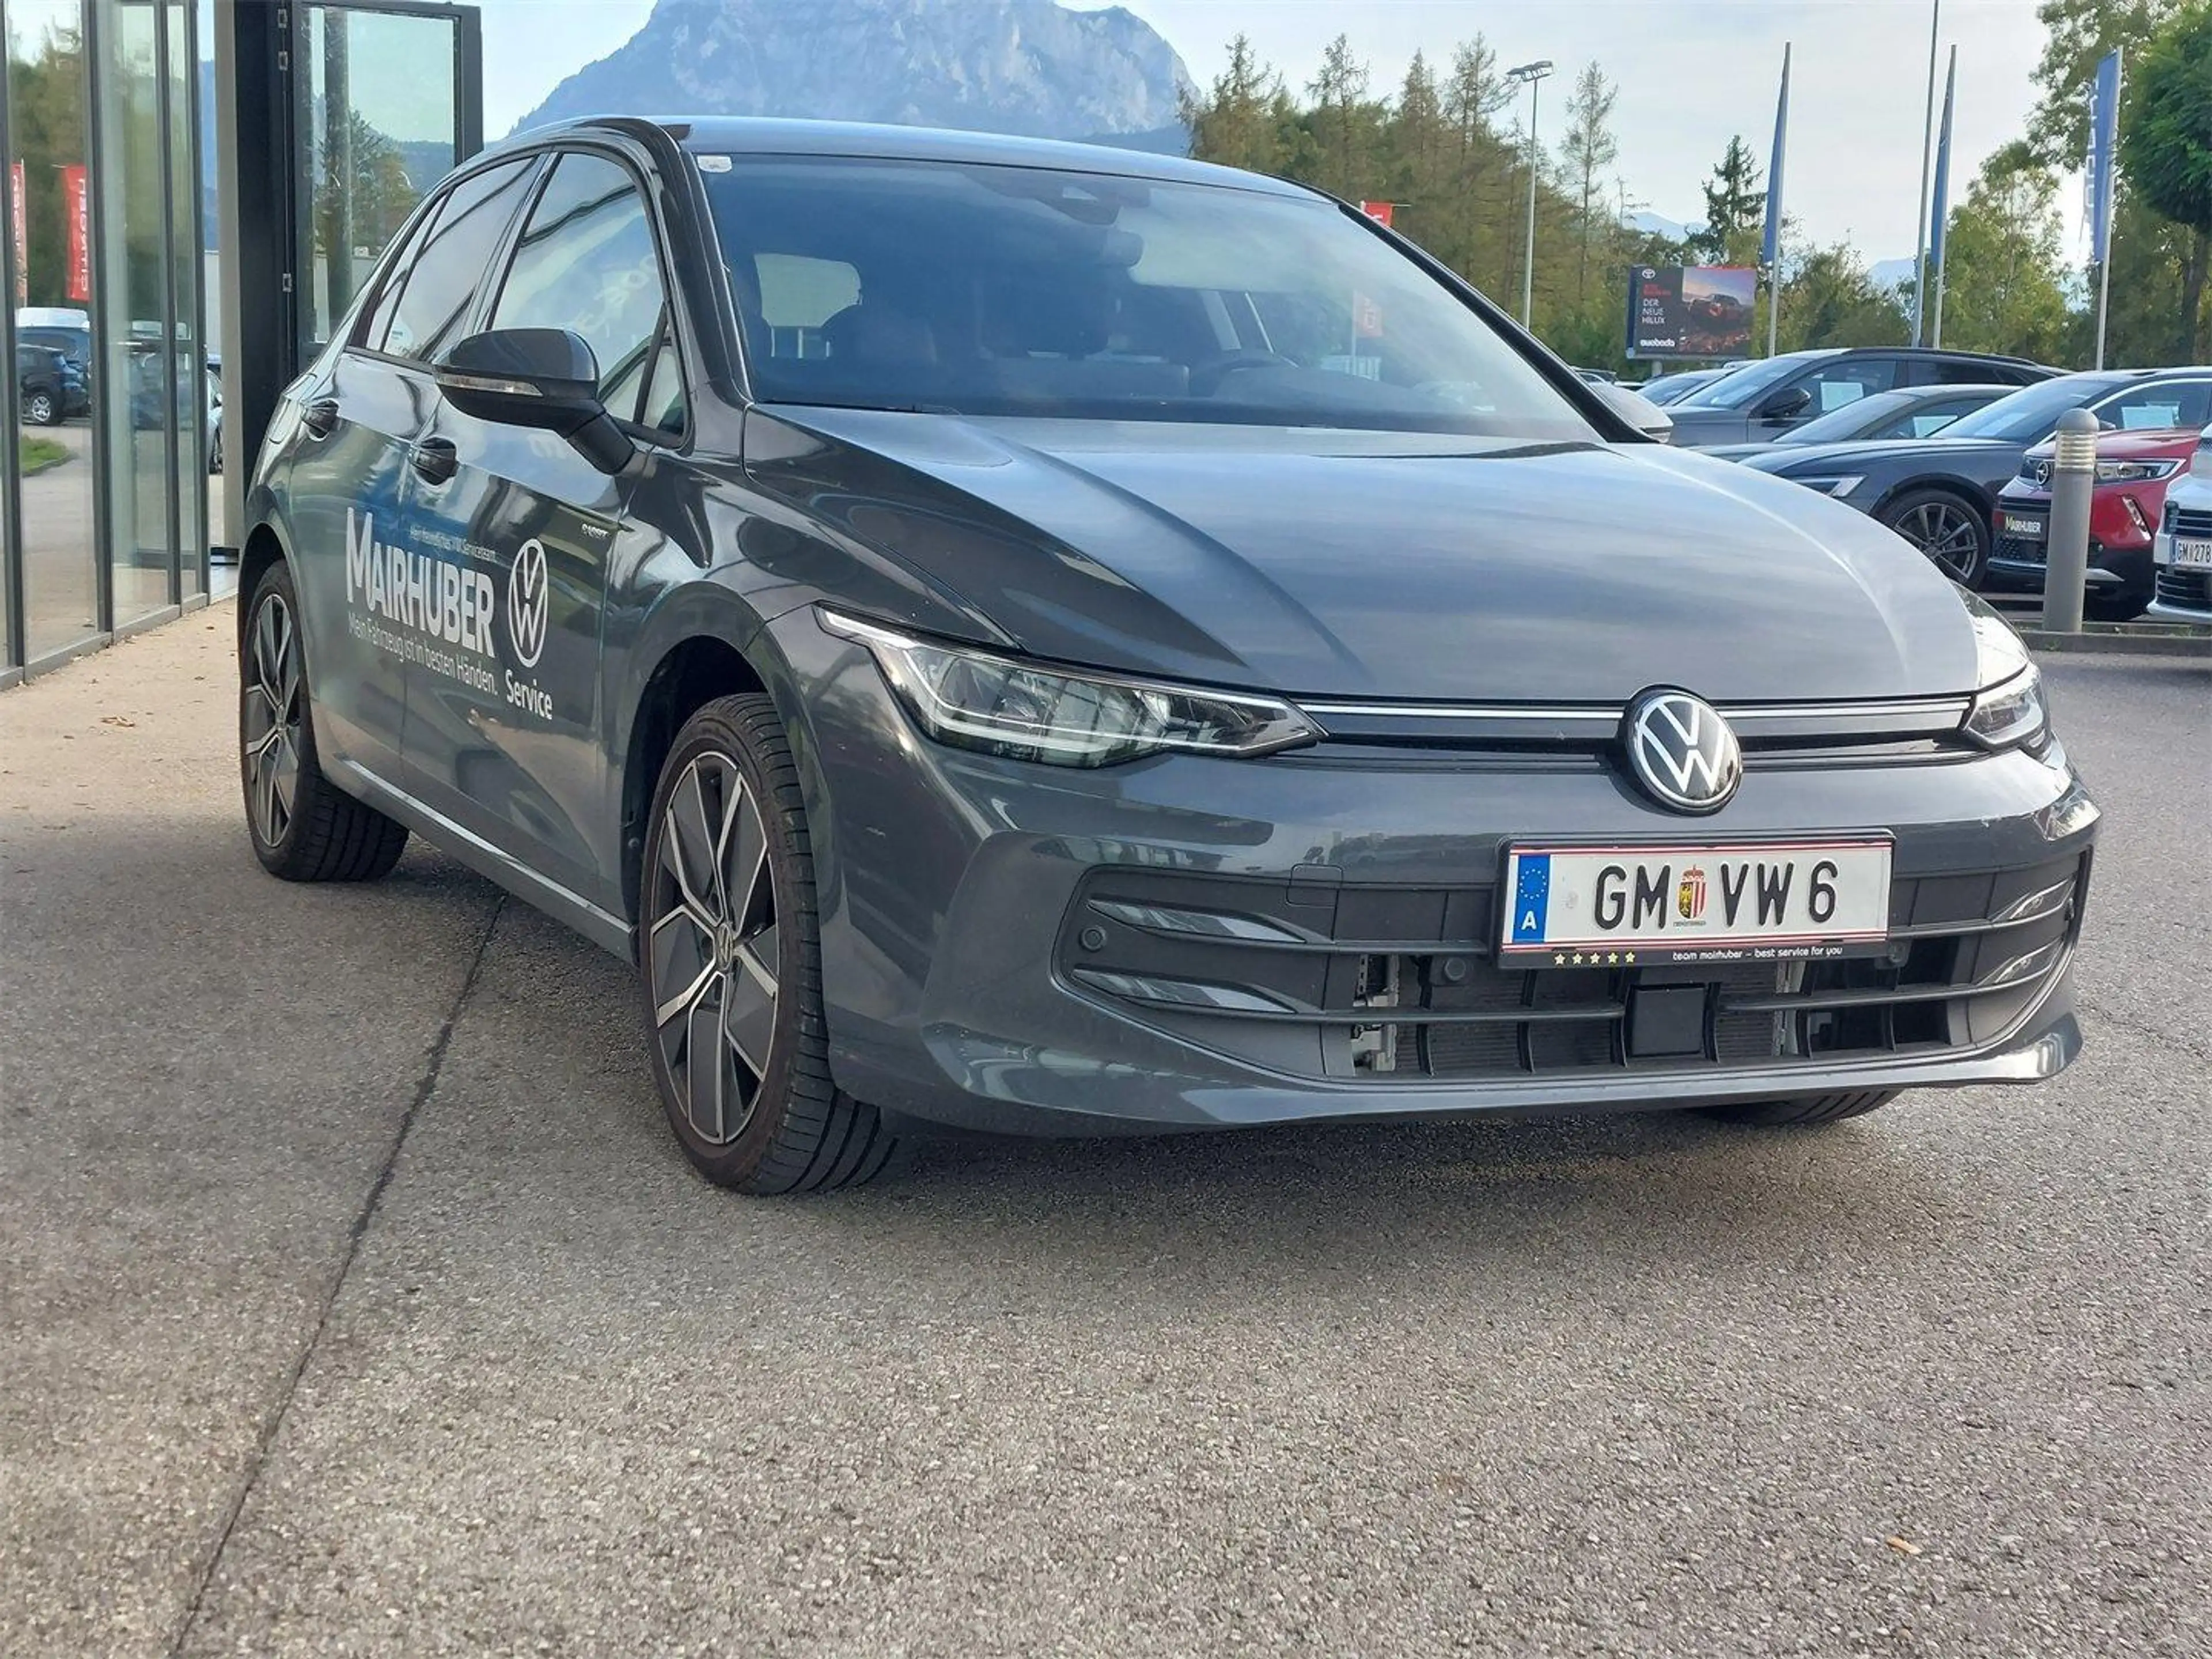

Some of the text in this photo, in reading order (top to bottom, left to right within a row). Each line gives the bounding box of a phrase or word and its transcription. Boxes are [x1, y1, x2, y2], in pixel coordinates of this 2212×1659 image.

[505, 669, 552, 720] Service
[1594, 860, 1838, 930] GM VW 6
[1521, 910, 1537, 930] A
[1672, 952, 1697, 961] team
[1699, 949, 1743, 960] mairhuber
[1754, 948, 1775, 958] best
[1777, 946, 1809, 957] service
[1810, 946, 1824, 956] for
[1825, 946, 1843, 957] you
